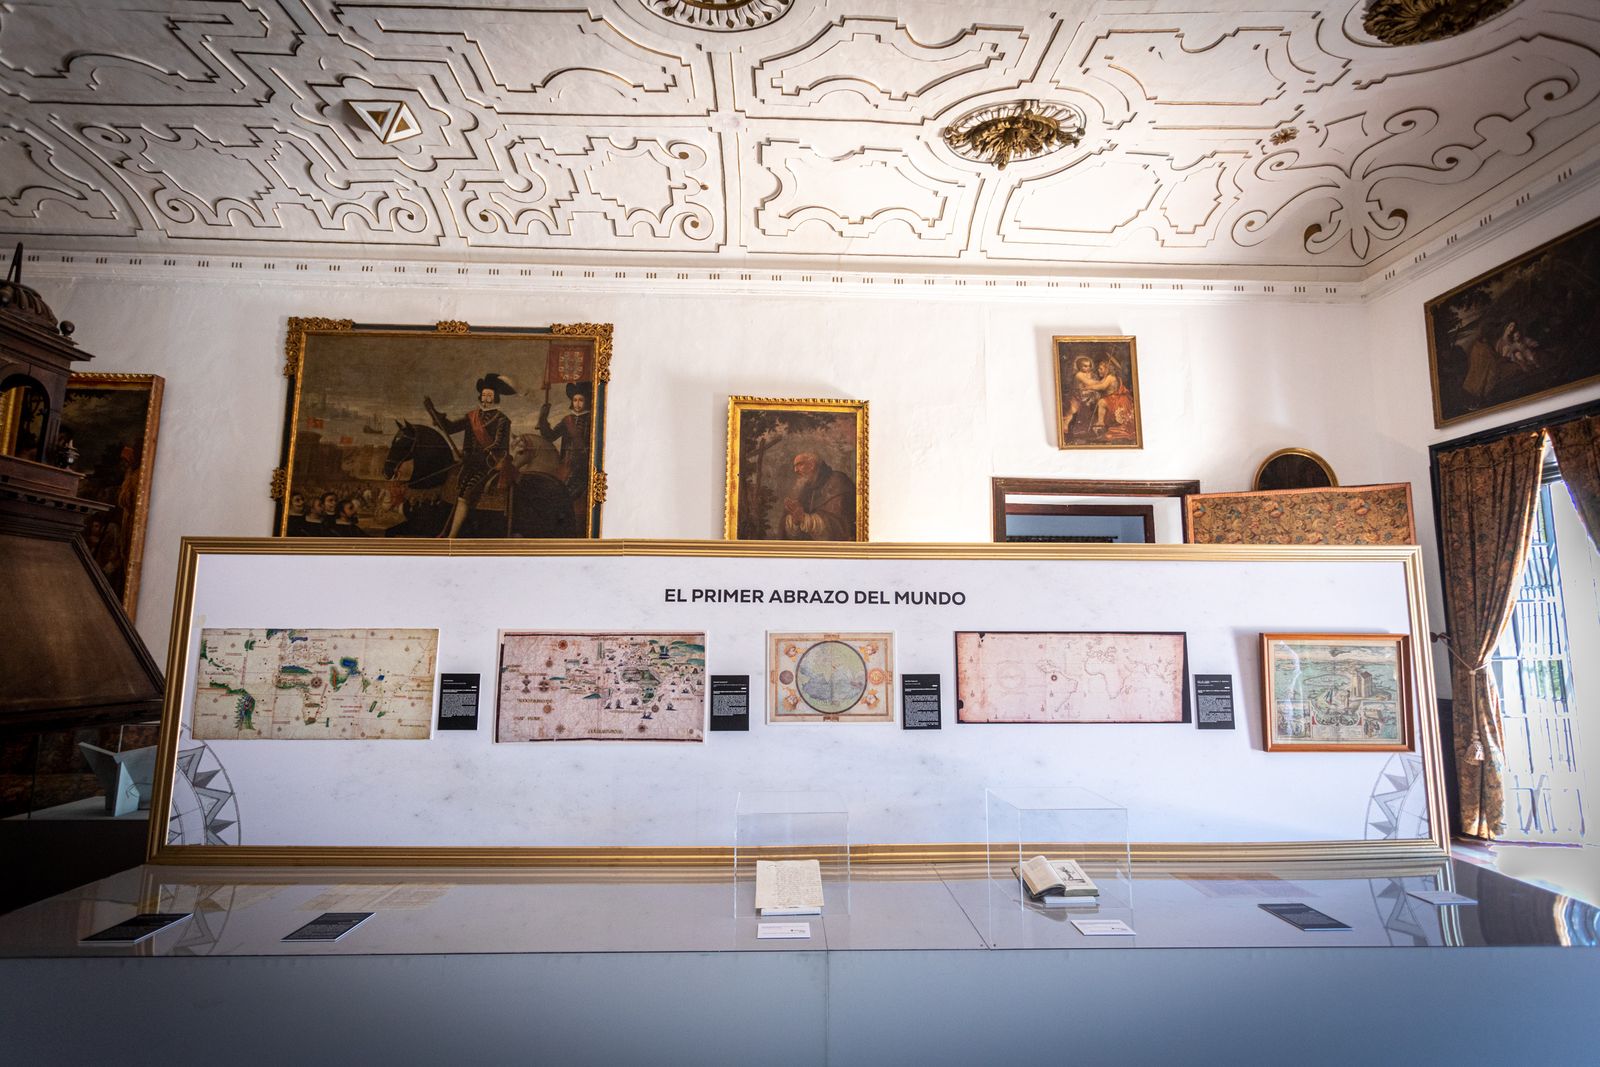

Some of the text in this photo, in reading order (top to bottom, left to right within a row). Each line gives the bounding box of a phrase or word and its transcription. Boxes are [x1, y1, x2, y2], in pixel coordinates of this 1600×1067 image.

[664, 588, 966, 606] EL PRIMER ABRAZO DEL MUNDO
